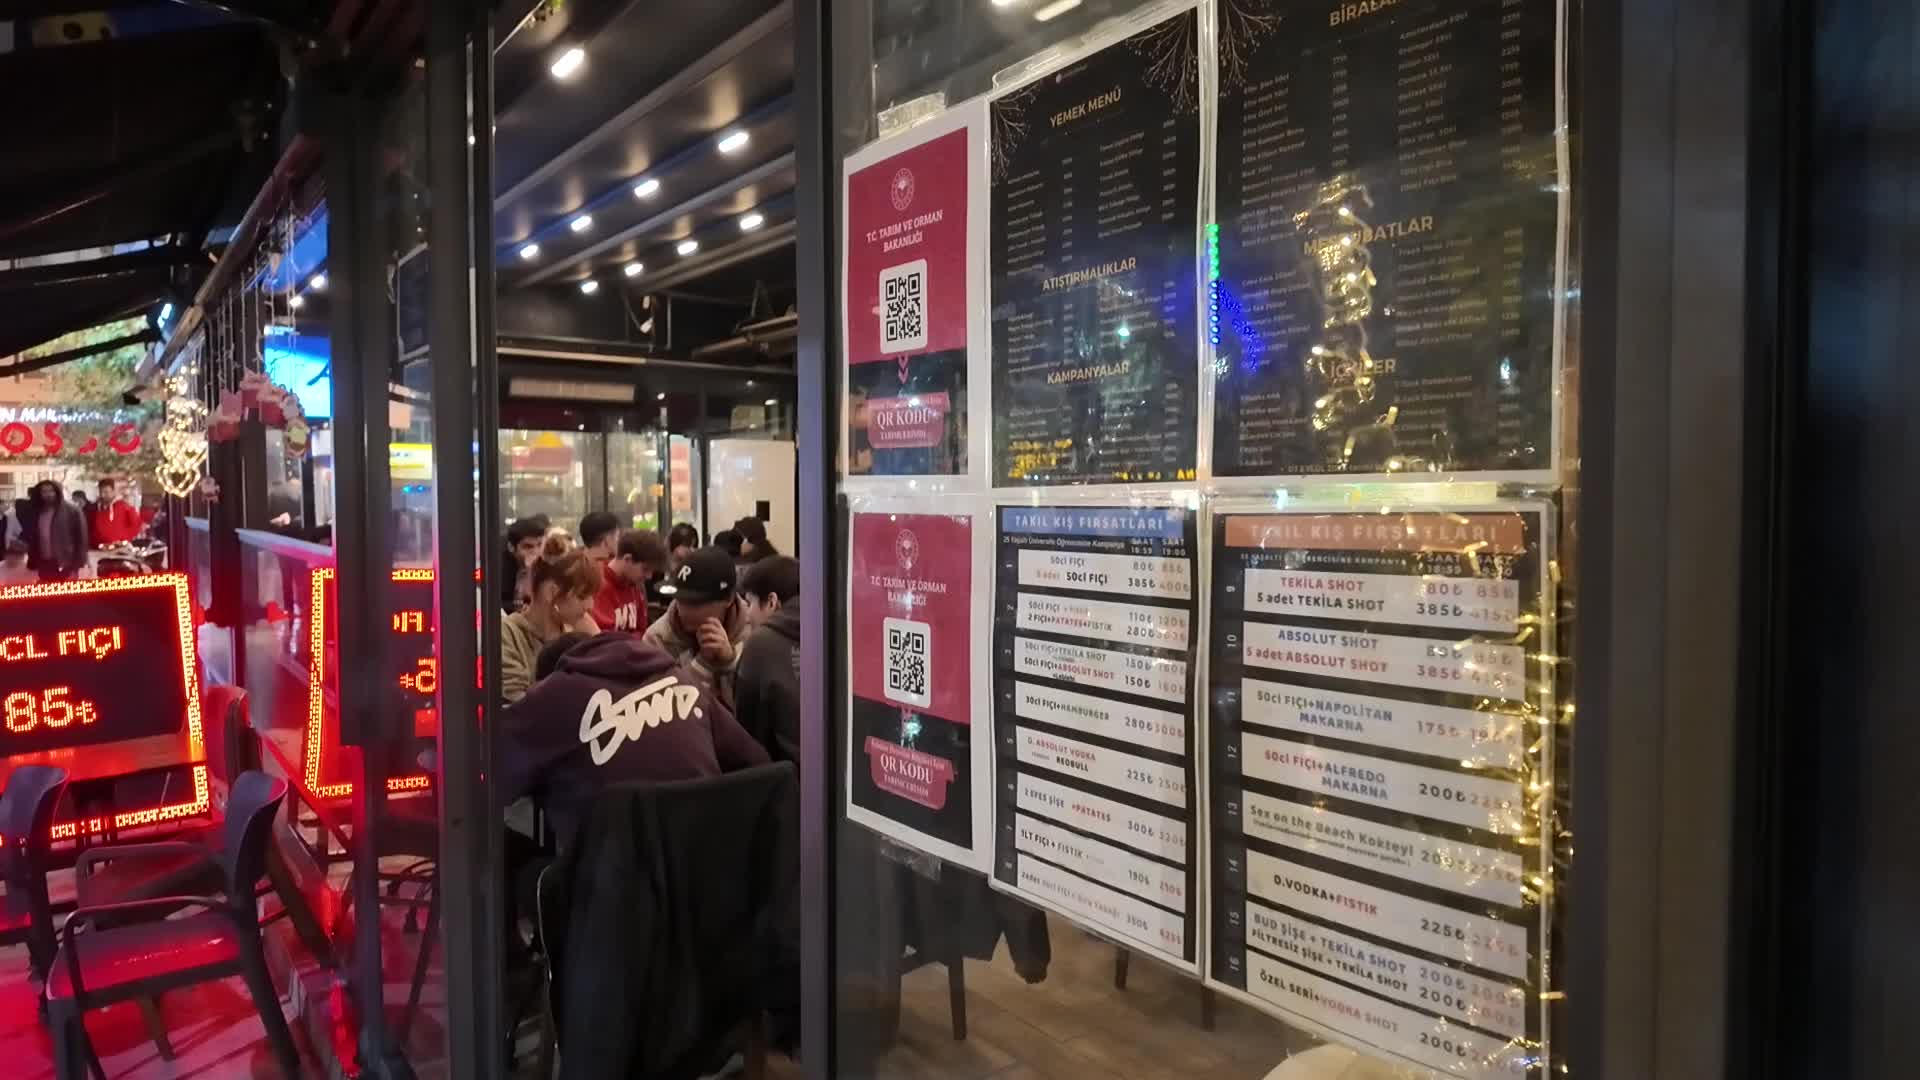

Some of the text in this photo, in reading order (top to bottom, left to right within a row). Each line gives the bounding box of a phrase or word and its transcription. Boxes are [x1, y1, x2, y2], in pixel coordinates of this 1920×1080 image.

[1050, 84, 1122, 128] YEMEK MENÜ
[879, 222, 903, 240] TARIM
[902, 218, 914, 232] VE
[914, 209, 944, 228] ORMAN
[884, 230, 924, 252] BAKANLIĞI
[1042, 256, 1137, 291] ATIŞTIRMALIKLAR
[1047, 359, 1130, 385] KAMPANYALAR
[877, 407, 931, 429] QR KODU
[1015, 515, 1049, 528] TAKIL
[1053, 516, 1073, 531] KIŞ
[1311, 525, 1345, 541] KIŞ
[1069, 556, 1086, 568] FIÇI
[1427, 554, 1461, 564] SAAT
[917, 580, 947, 594] ORMAN
[1066, 571, 1087, 583] 50cl
[1089, 573, 1108, 587] FIÇI
[1281, 577, 1324, 591] TEKİLA
[1327, 579, 1364, 593] SHOT
[1045, 602, 1061, 614] FIÇI
[1257, 592, 1264, 603] 5
[1267, 593, 1295, 606] adet
[1298, 594, 1343, 609] TEKİLA
[1347, 598, 1385, 612] SHOT
[58, 626, 121, 660] FIÇI
[1278, 629, 1337, 645] ABSOLUT
[1341, 636, 1379, 650] SHOT
[1086, 650, 1108, 662] SHOT
[1256, 648, 1283, 661] adet
[1286, 652, 1346, 668] ABSOLUT
[1350, 660, 1389, 674] SHOT
[1093, 668, 1115, 680] SHOT
[1284, 696, 1393, 722] FIÇI+NAPOLİTAN
[1299, 712, 1364, 733] MAKARNA
[1036, 738, 1067, 755] ABSOLUT
[1069, 747, 1096, 761] VODKA
[880, 752, 897, 774] QR
[899, 759, 934, 785] KODU
[1030, 789, 1048, 802] EFES
[1322, 776, 1388, 801] MAKARNA
[1250, 805, 1271, 818] Sex
[1273, 810, 1289, 823] on
[1291, 812, 1312, 832] the
[1314, 822, 1355, 842] Beach
[1358, 830, 1415, 858] Kokteyl
[1034, 833, 1050, 848] FIÇI
[1058, 841, 1084, 860] FISTIK
[1273, 873, 1378, 916] D.VODKA+FISTIK
[1253, 911, 1278, 930] BUD
[1281, 920, 1306, 942] ŞİŞE
[1321, 936, 1366, 962] TEKİLA
[1369, 953, 1408, 976] SHOT
[1301, 946, 1325, 965] ŞİŞE
[1336, 958, 1374, 982] TEKİLA
[1376, 974, 1409, 993] SHOT
[1259, 967, 1287, 991] ÖZEL
[1289, 982, 1362, 1020] SERİ+VODKA
[1363, 1011, 1400, 1034] SHOT
